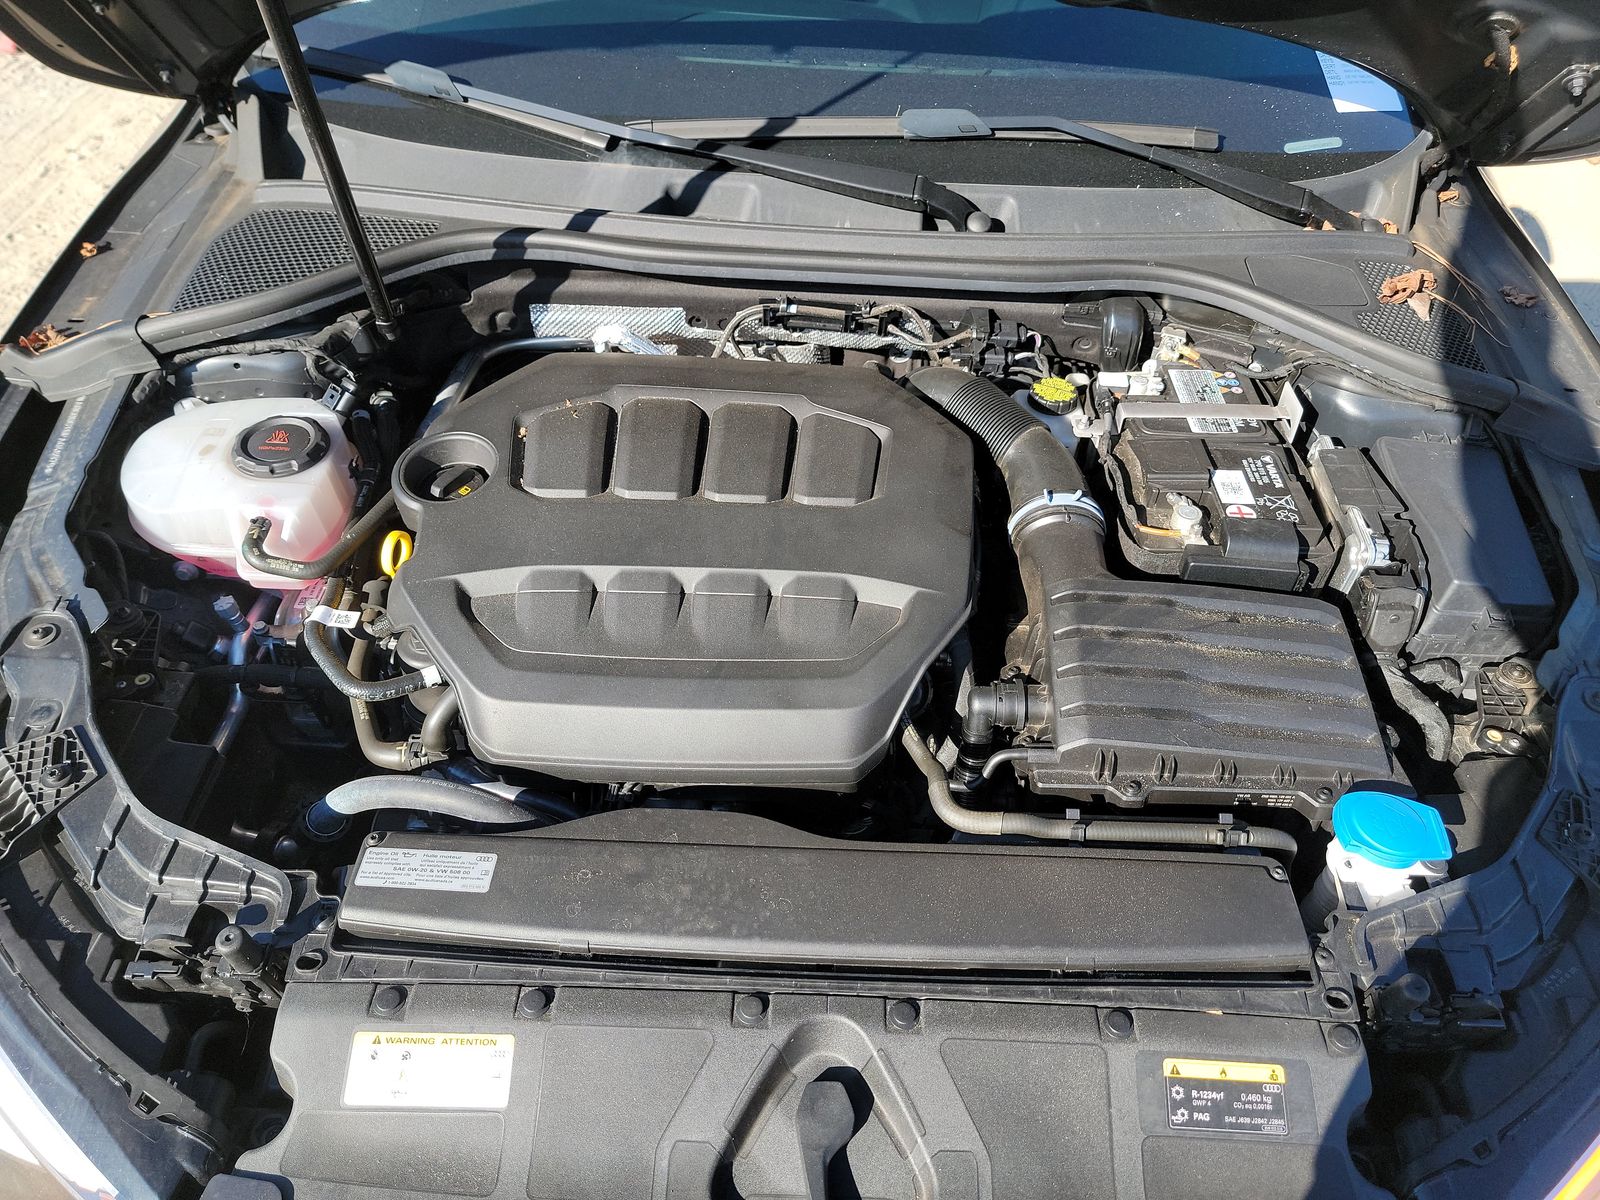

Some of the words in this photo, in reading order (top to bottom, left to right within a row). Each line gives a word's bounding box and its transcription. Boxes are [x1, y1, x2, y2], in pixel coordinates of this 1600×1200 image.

[1265, 463, 1284, 489] VARTA
[386, 1037, 435, 1045] WARNING
[441, 1038, 498, 1046] ATTENTION
[1192, 1090, 1224, 1101] R-1234yf
[1263, 1094, 1272, 1104] kg
[1193, 1112, 1210, 1121] PAG
